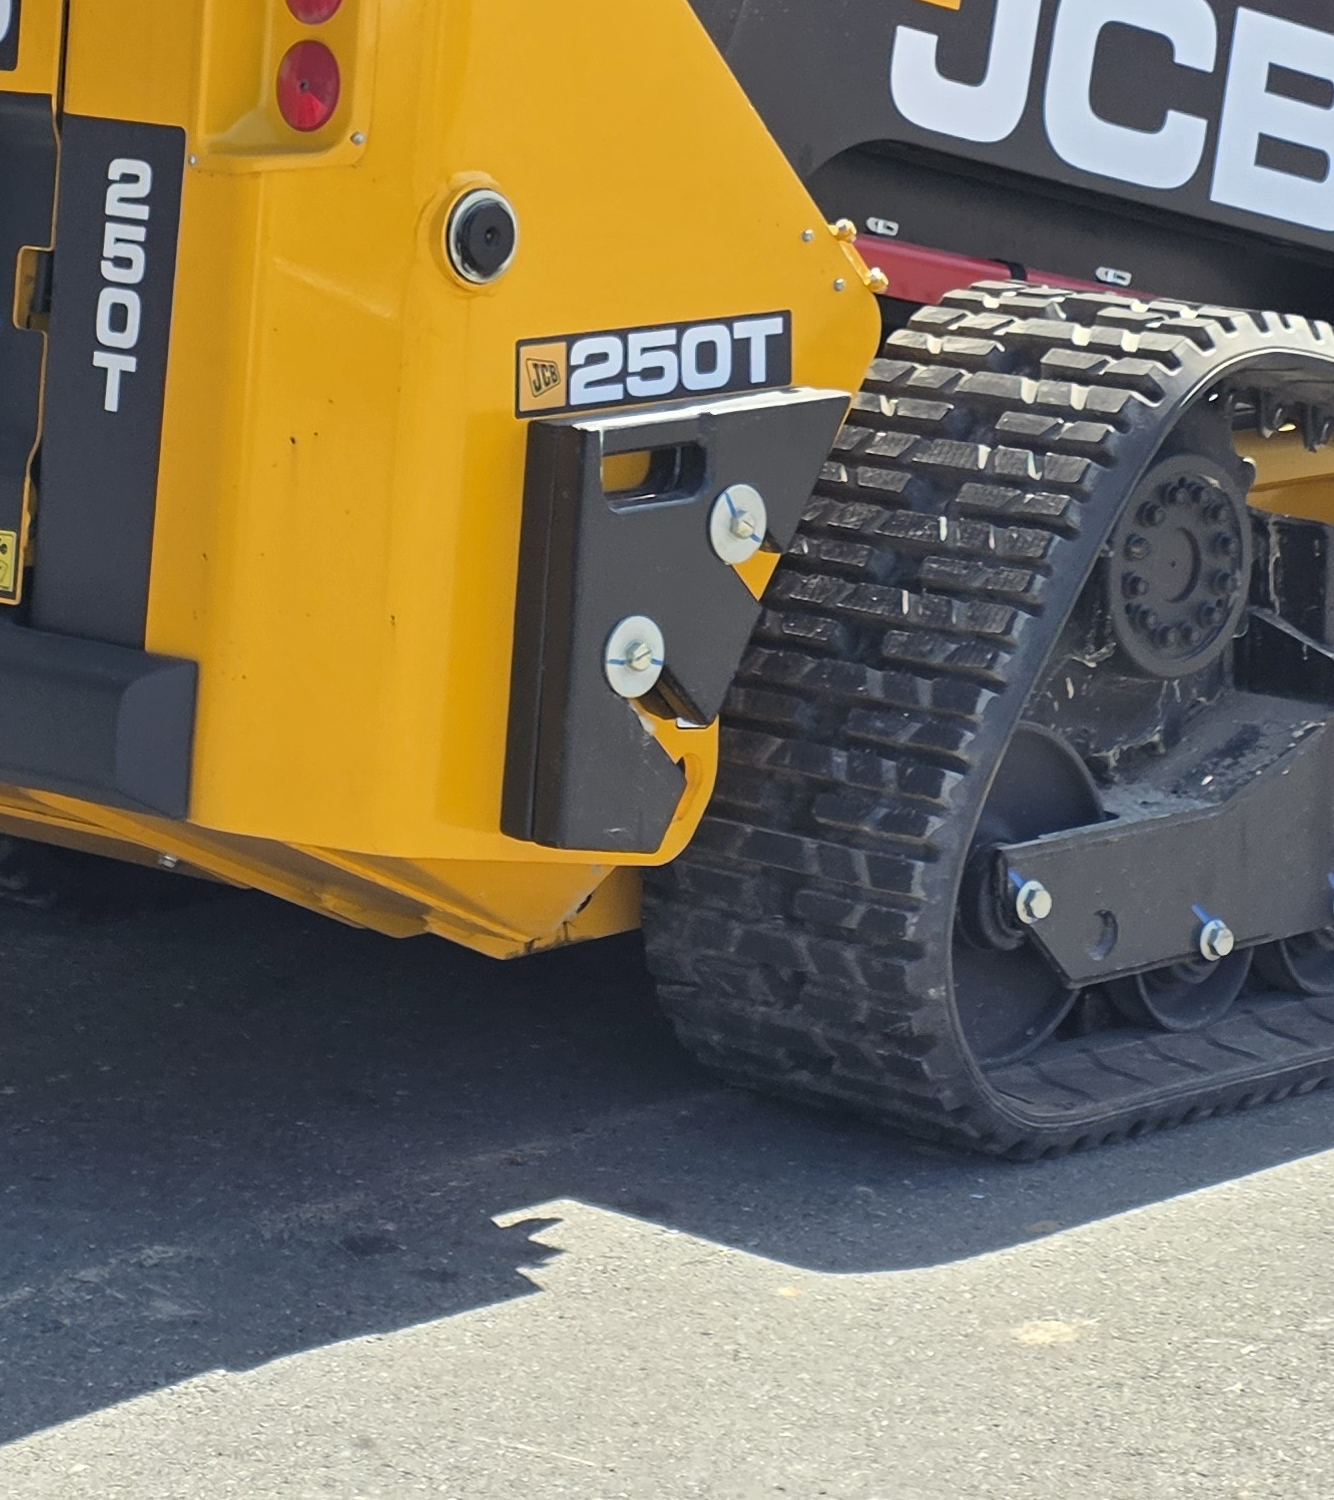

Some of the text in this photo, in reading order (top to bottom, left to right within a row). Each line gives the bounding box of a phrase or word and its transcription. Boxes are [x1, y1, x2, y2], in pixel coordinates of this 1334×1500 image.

[92, 158, 152, 412] 250T
[532, 361, 558, 393] JCB
[569, 317, 784, 406] 250T
